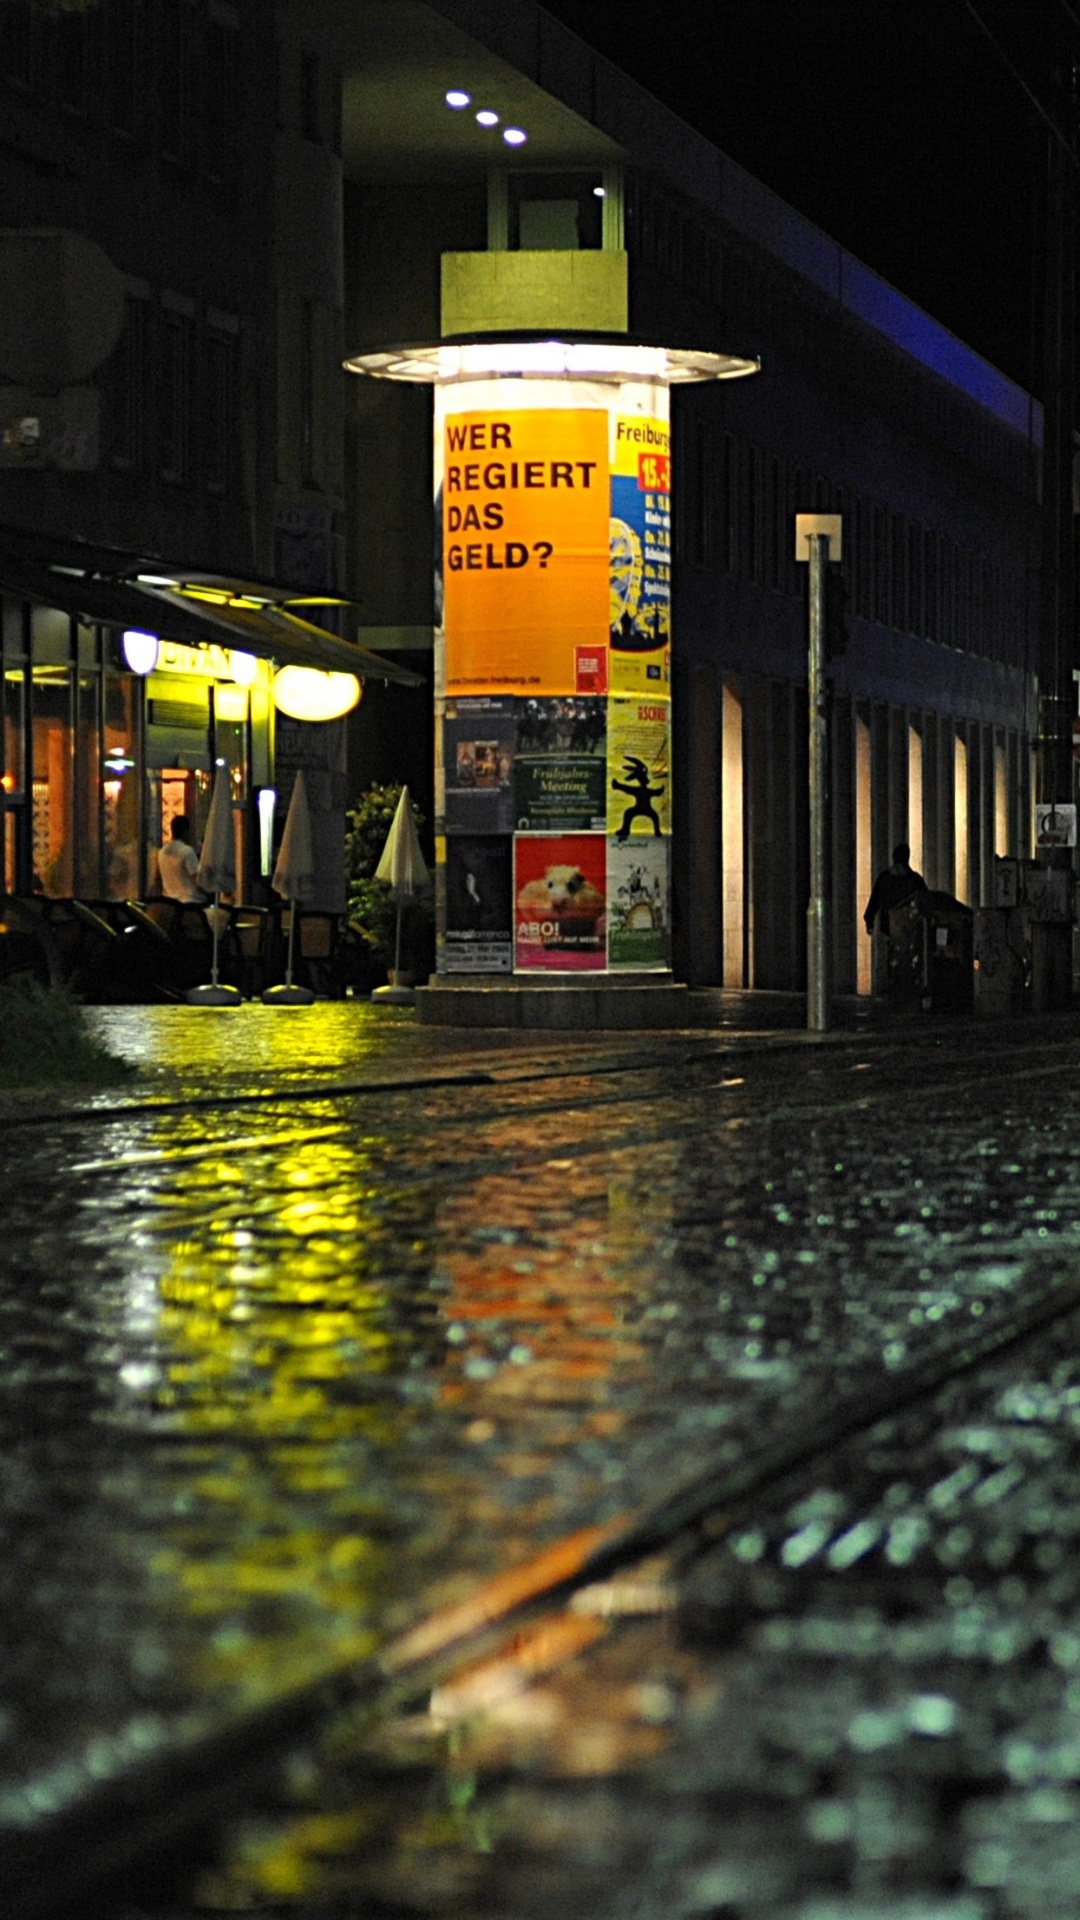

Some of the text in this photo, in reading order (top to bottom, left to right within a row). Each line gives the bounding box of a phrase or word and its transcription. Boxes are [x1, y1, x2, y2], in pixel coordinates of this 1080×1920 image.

[447, 423, 513, 452] WER
[448, 462, 597, 492] REGIERT
[448, 503, 505, 532] DAS
[448, 541, 554, 571] GELD?
[539, 780, 588, 793] Meeting
[517, 921, 560, 936] ABO!
